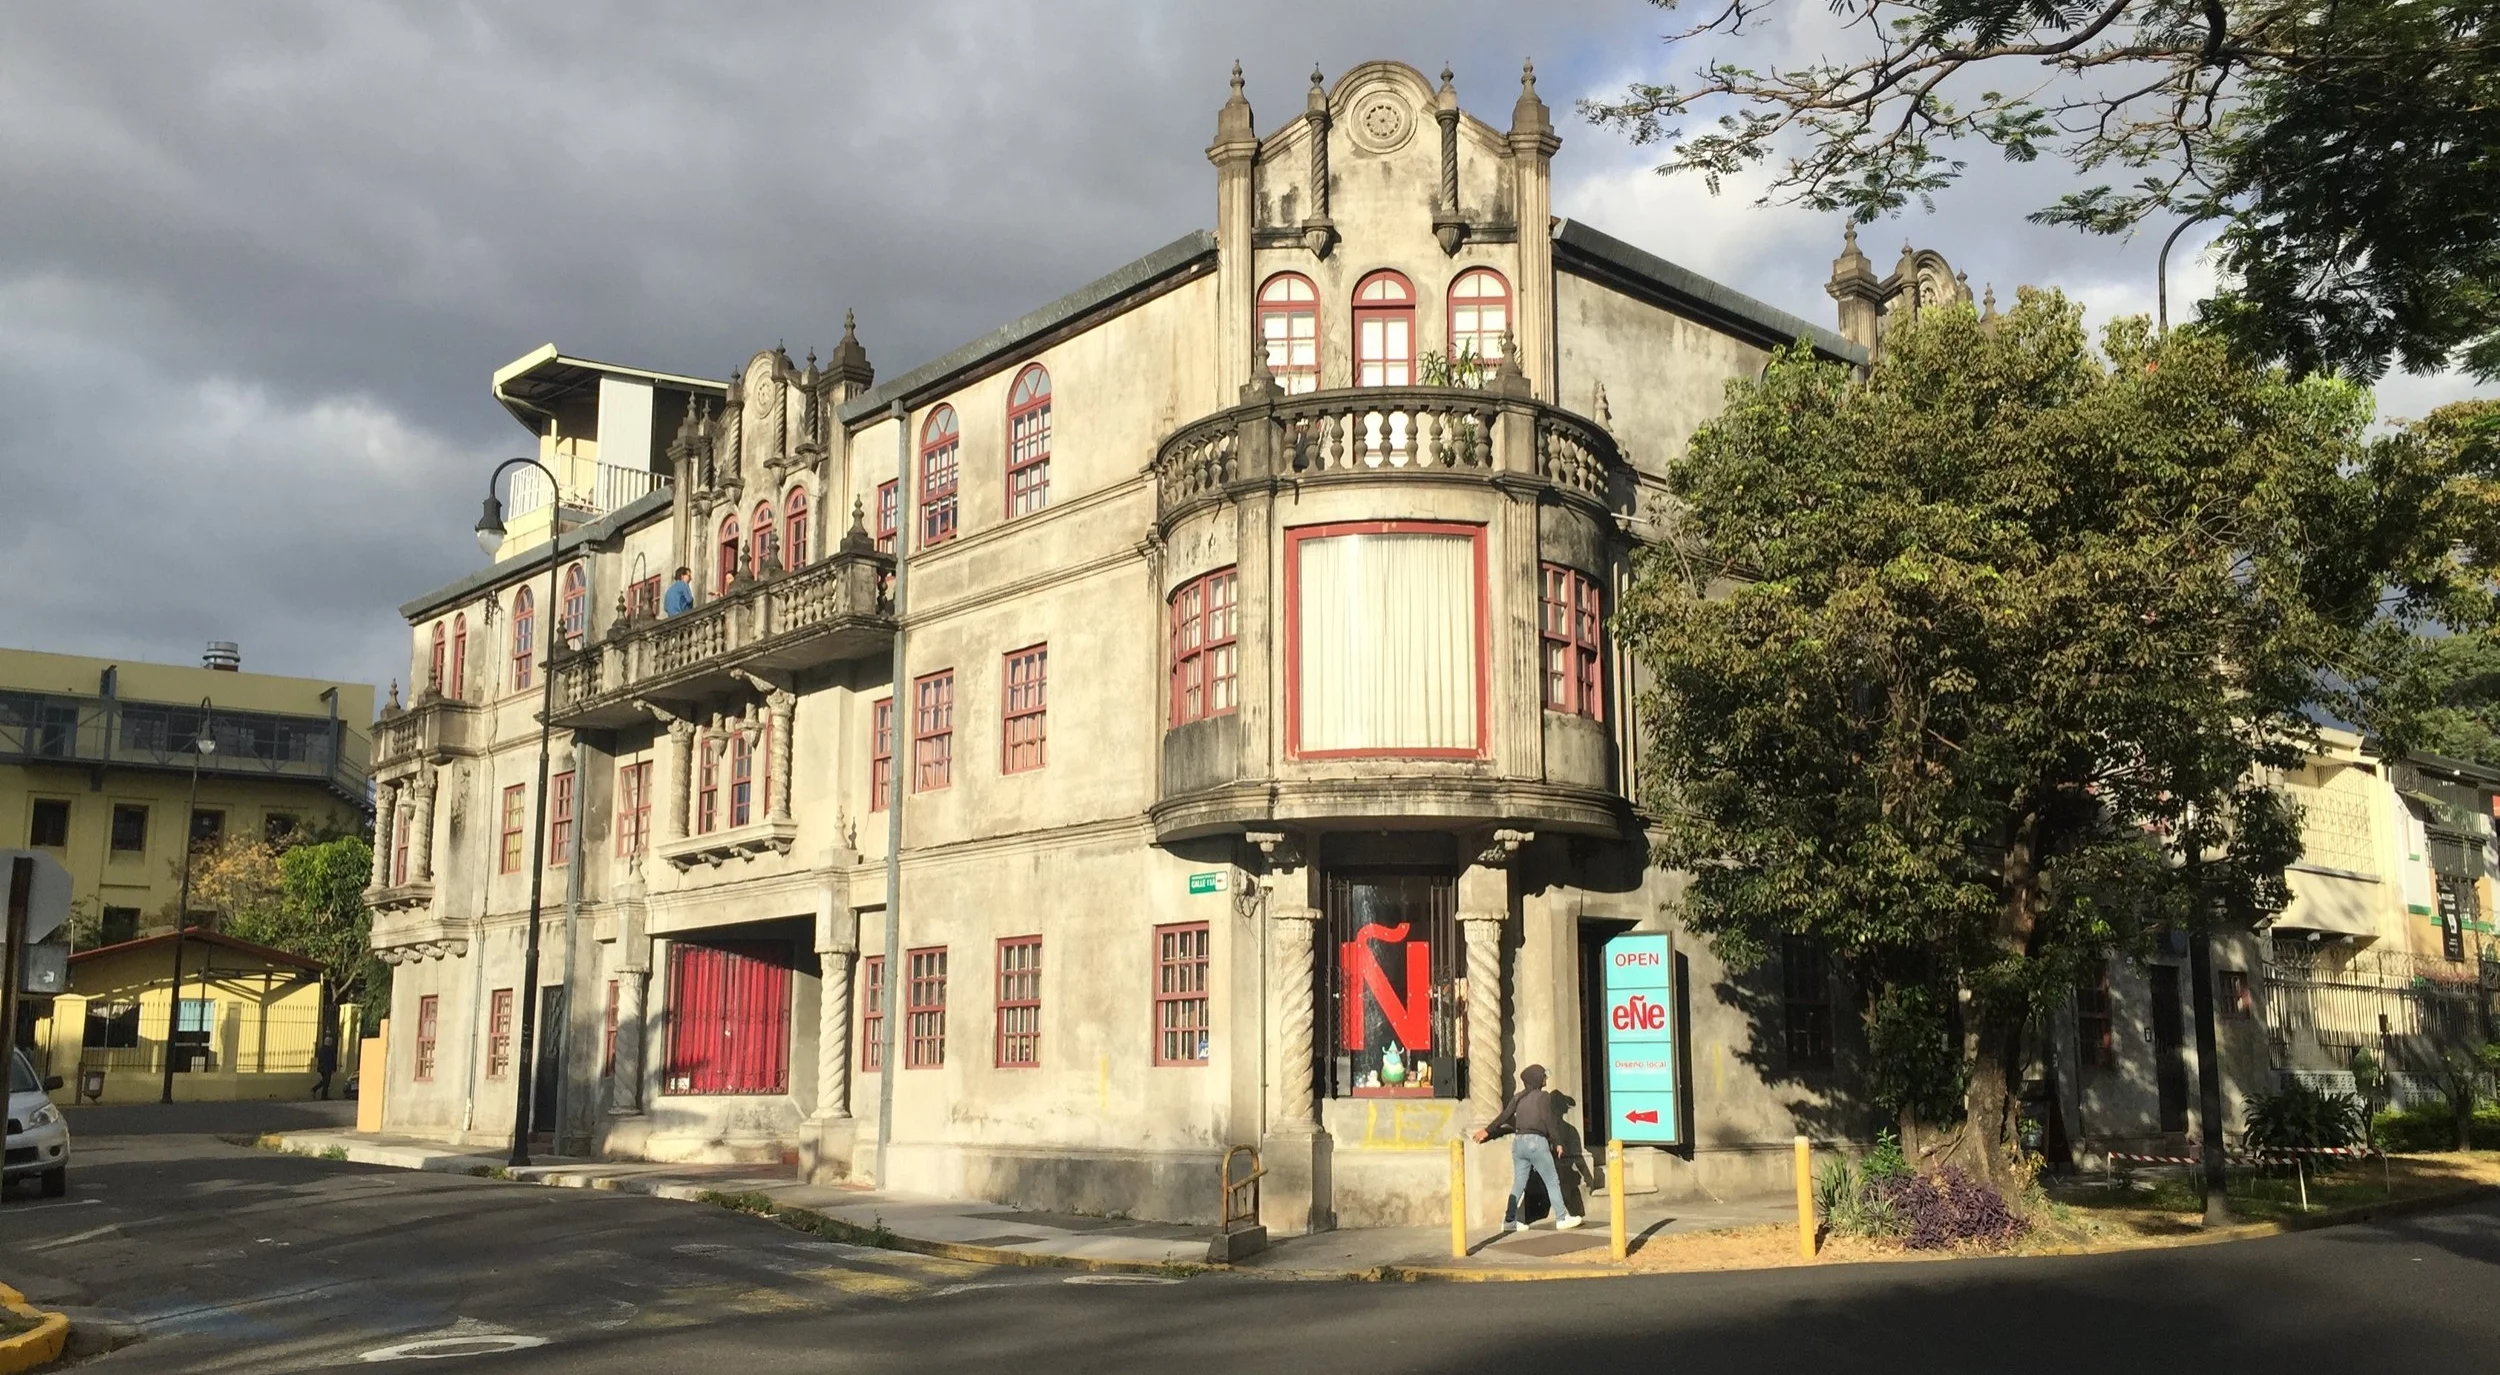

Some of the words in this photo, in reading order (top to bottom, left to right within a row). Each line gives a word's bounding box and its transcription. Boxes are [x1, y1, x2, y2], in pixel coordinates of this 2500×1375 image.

[1191, 878, 1206, 888] CALLE
[1615, 952, 1659, 967] OPEN
[1341, 922, 1431, 1051] Ñ
[1612, 995, 1665, 1030] eÑe
[1646, 1060, 1667, 1068] local
